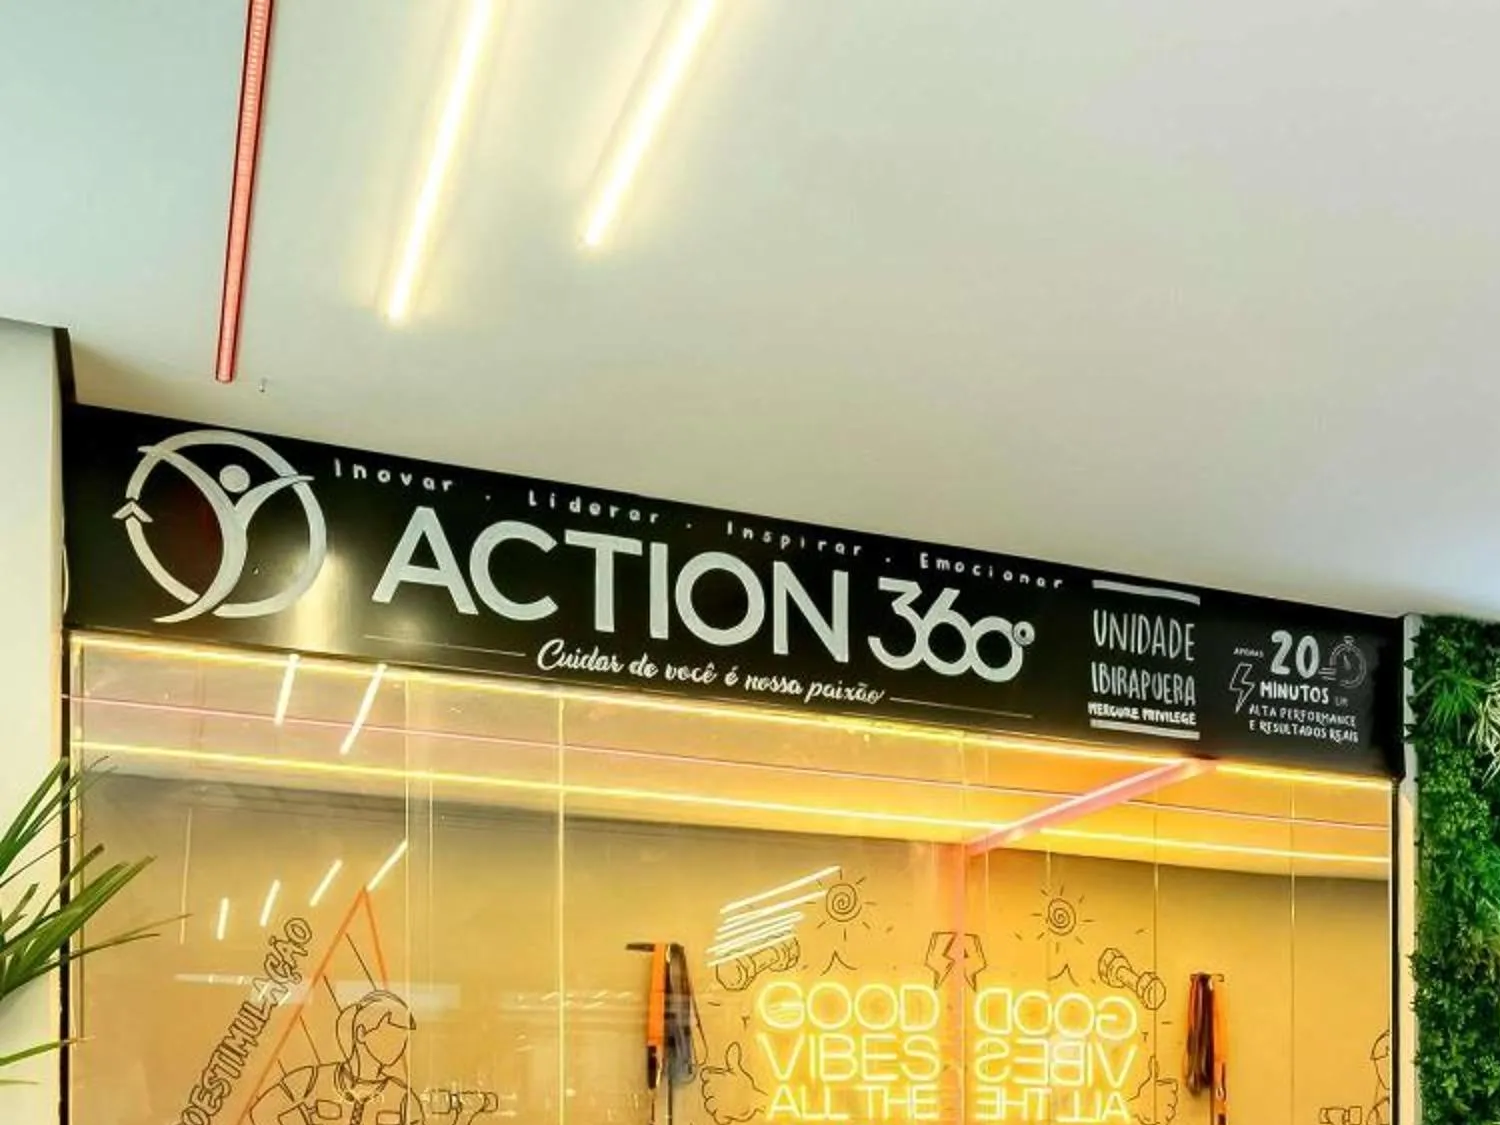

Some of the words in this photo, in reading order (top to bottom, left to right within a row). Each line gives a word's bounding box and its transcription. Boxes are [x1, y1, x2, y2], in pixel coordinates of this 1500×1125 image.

[333, 458, 453, 492] Inovar
[528, 490, 659, 524] Liderar
[727, 520, 862, 557] Inspirar
[919, 552, 1064, 589] Emocionar
[371, 506, 849, 665] ACTION
[1092, 608, 1195, 662] UNIDADE
[1270, 629, 1320, 679] 20
[537, 638, 624, 673] Cuidar
[628, 653, 659, 679] de
[664, 662, 718, 684] você
[724, 665, 739, 687] é
[745, 674, 802, 695] nossa
[803, 678, 885, 705] paixão
[1090, 661, 1196, 707] IBIRAPUERA
[1259, 680, 1329, 705] MINUTOS
[1248, 719, 1255, 731] E
[1259, 720, 1327, 739] RESULTADOS
[1249, 703, 1277, 717] ALTA
[1279, 706, 1357, 728] PERFORMANCE
[757, 981, 940, 1032] GOOD
[755, 1032, 941, 1082] VIBES
[767, 1084, 849, 1120] ALL
[856, 1083, 940, 1120] THE
